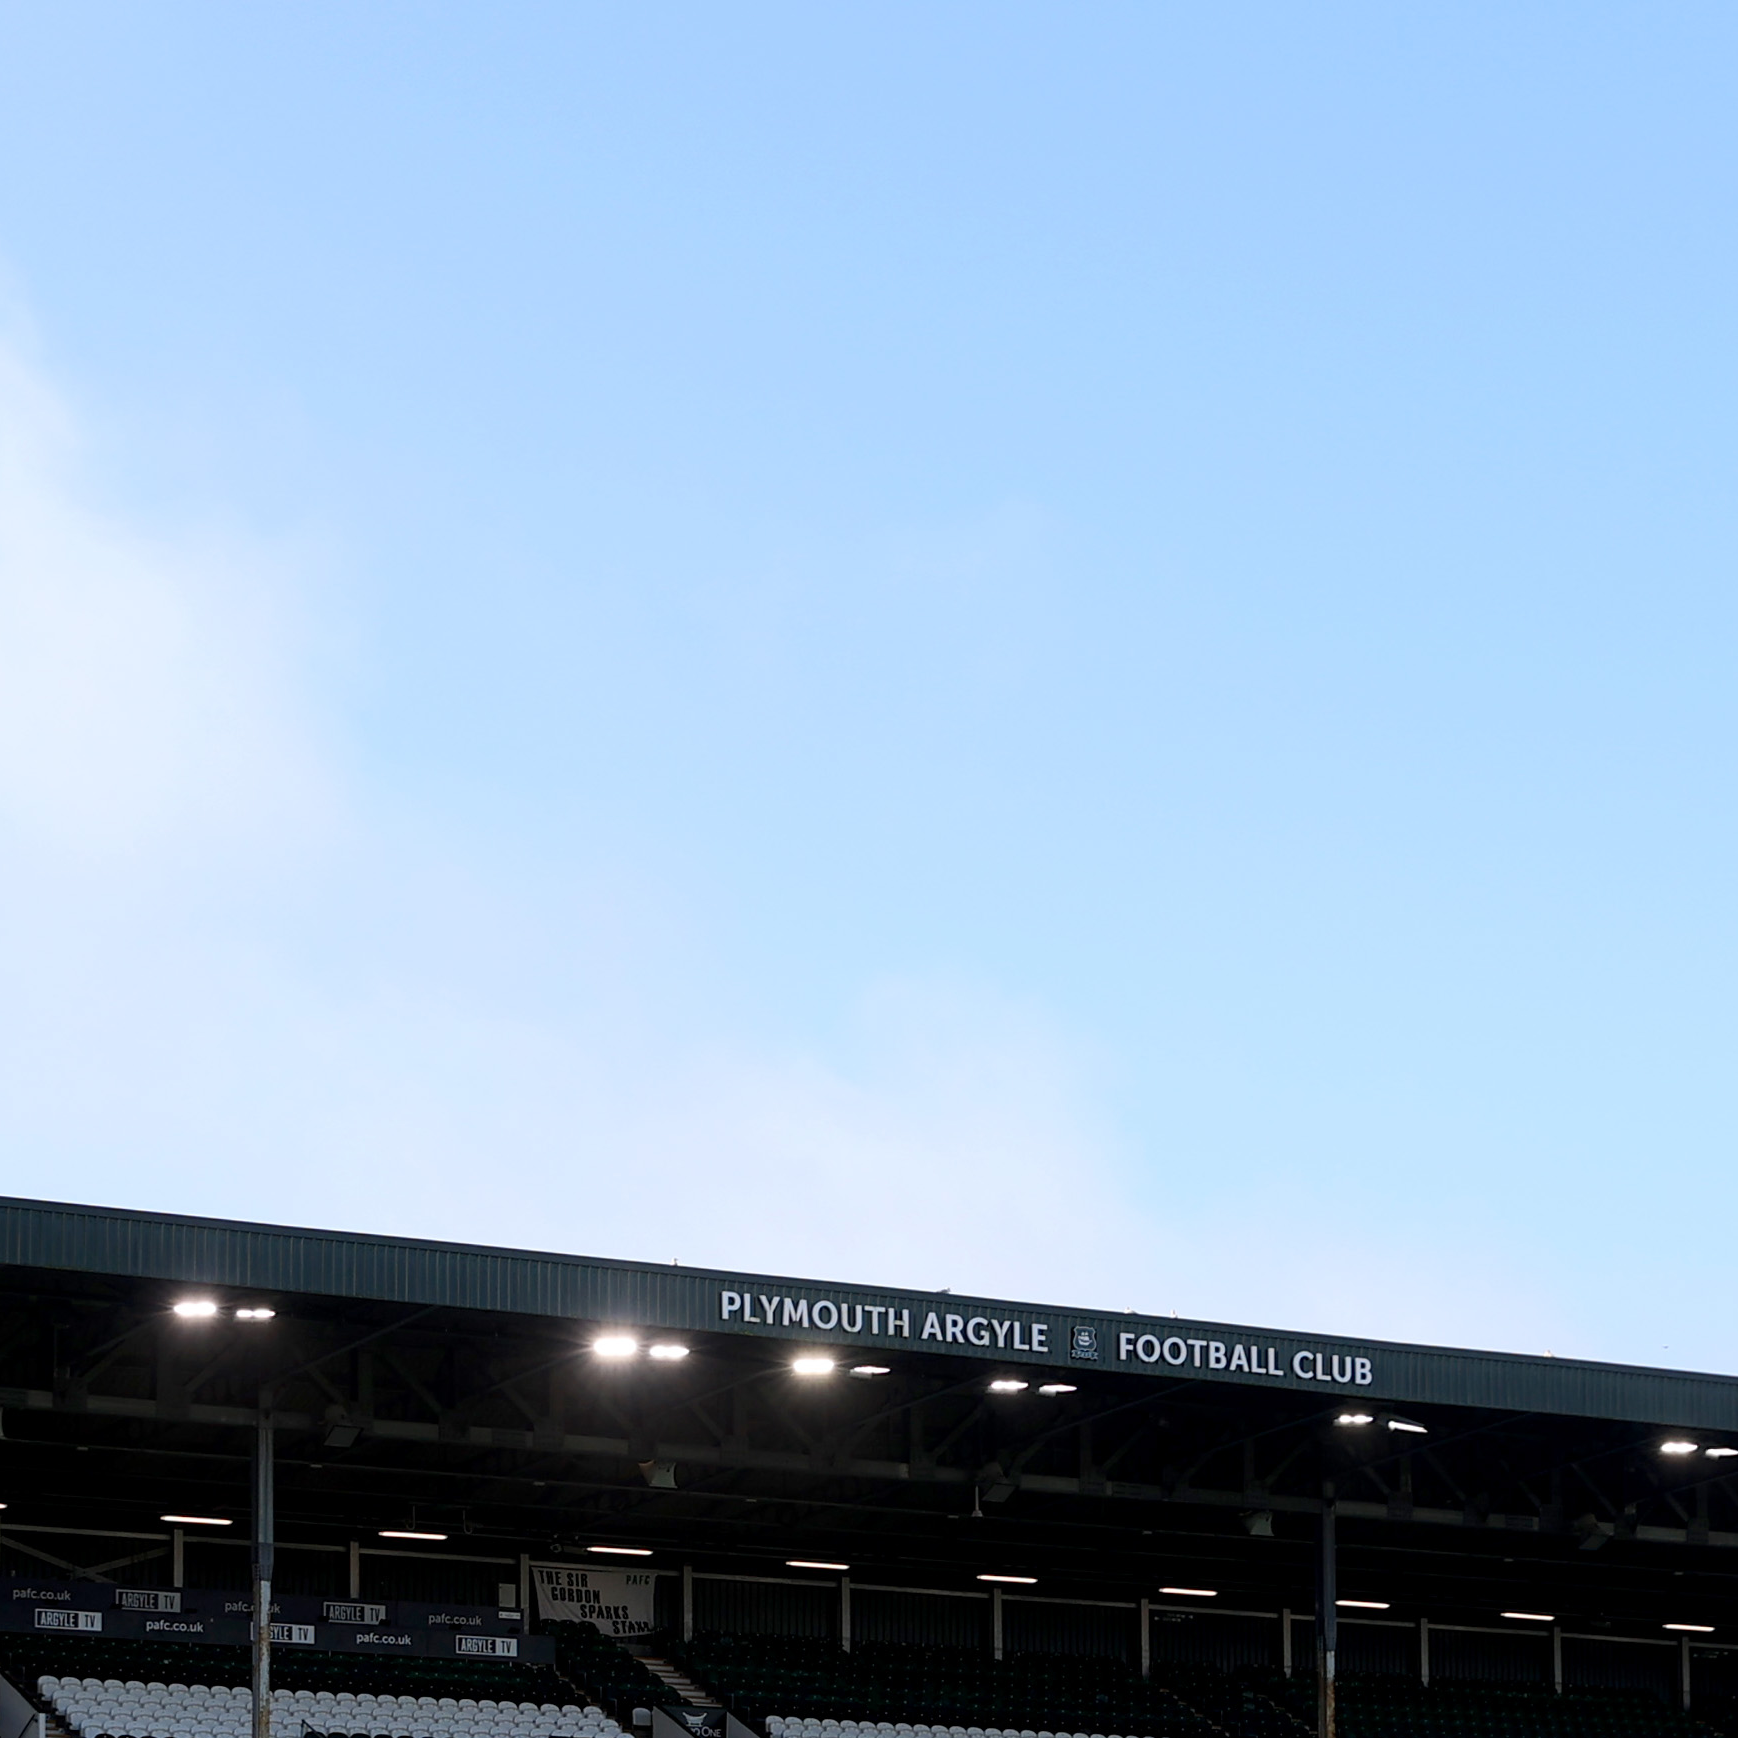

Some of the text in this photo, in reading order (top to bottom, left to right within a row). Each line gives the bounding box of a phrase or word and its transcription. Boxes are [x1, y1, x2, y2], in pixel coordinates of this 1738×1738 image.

[721, 1291, 1049, 1353] PLYMOUTH ARGYLE
[1119, 1332, 1373, 1386] FOOTBALL CLUB
[538, 1570, 588, 1588] THE SIR
[626, 1574, 650, 1586] PAFC
[551, 1586, 601, 1604] GORDON
[580, 1605, 629, 1620] SPARKS
[146, 1619, 204, 1634] pafc.co.uk
[356, 1632, 412, 1646] pafc.co.uk
[460, 1638, 511, 1654] ARGYLE TV
